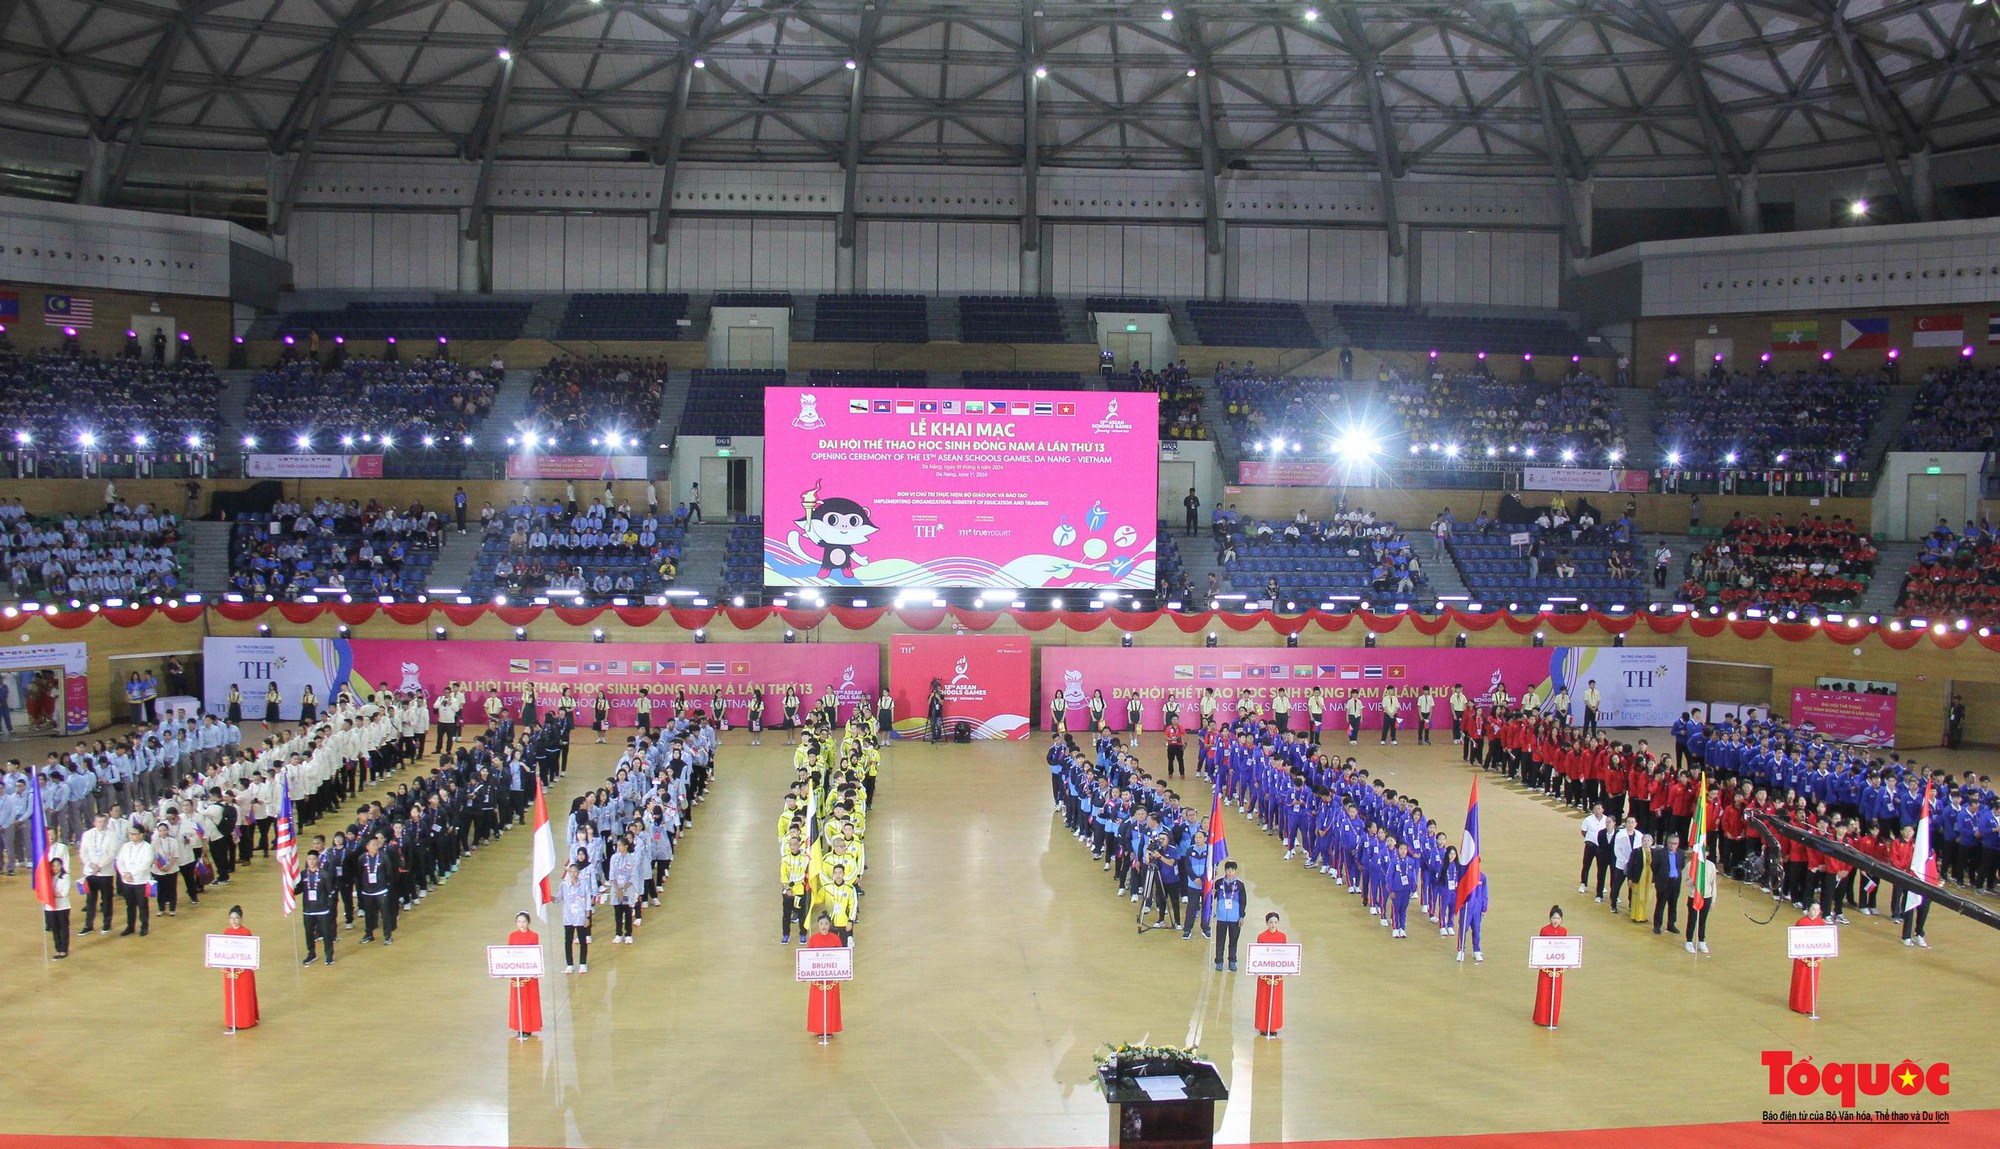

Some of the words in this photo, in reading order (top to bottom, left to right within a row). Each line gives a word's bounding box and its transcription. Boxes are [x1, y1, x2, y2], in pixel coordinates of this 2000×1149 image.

[910, 418, 927, 436] LỄ
[931, 422, 972, 436] KHAI
[976, 422, 1016, 441] MẠC
[819, 440, 838, 451] ĐẠI
[840, 438, 860, 452] HỘI
[863, 437, 883, 450] THỂ
[885, 440, 916, 450] THAO
[918, 441, 942, 452] HỌC
[945, 441, 970, 451] SINH
[1009, 442, 1035, 452] NAM
[1095, 443, 1105, 452] 13
[1004, 455, 1033, 463] GAMES,
[914, 525, 936, 538] TH
[239, 661, 272, 679] TH
[1623, 671, 1653, 688] TH
[607, 683, 640, 695] SINH
[800, 684, 813, 695] 13
[1602, 712, 1613, 720] TH
[214, 952, 252, 960] MALAYSIA
